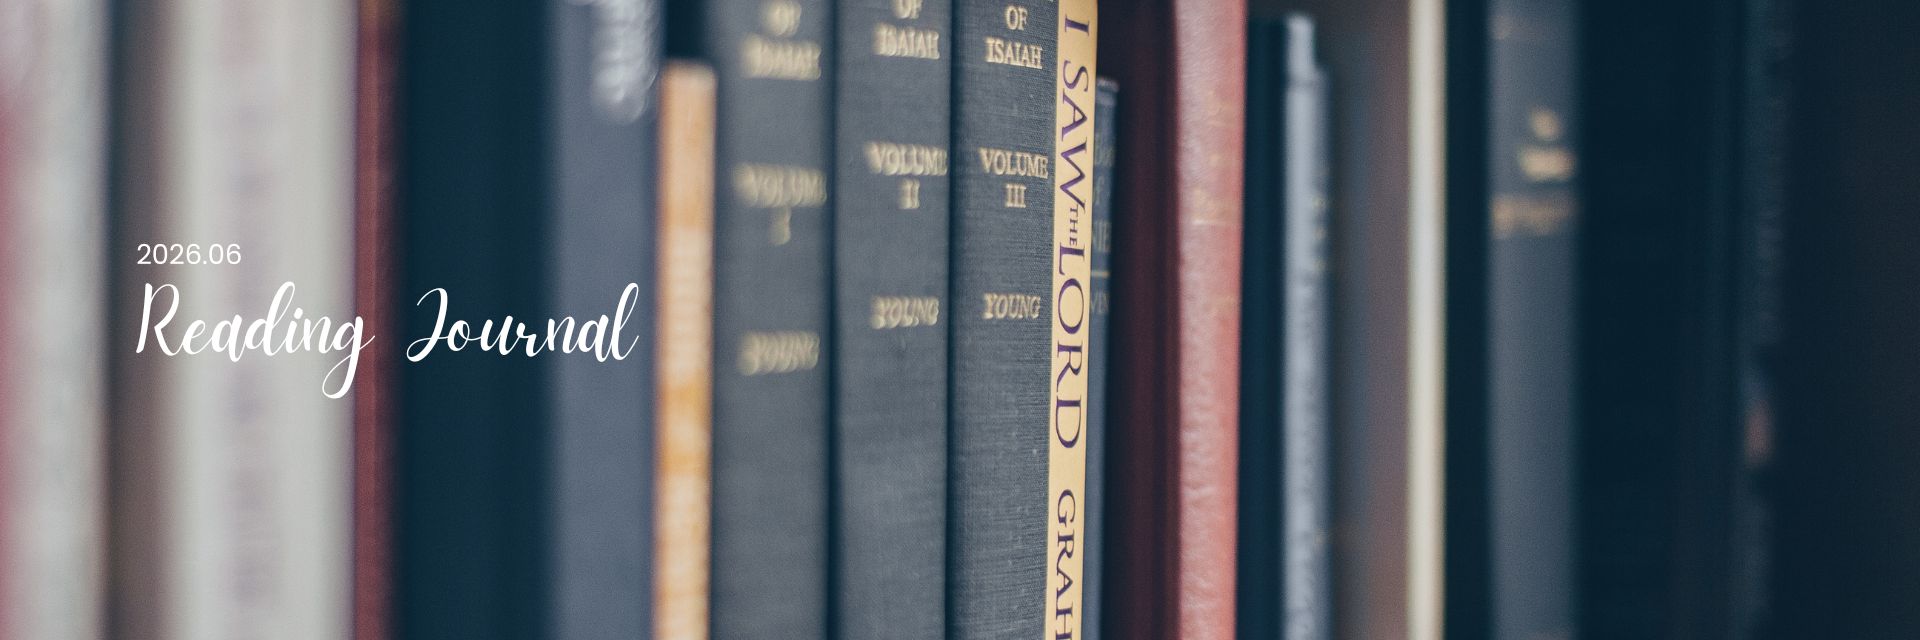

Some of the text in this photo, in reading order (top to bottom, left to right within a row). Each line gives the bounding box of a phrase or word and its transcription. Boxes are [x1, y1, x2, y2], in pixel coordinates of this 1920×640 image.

[1005, 5, 1028, 31] OF
[874, 23, 940, 60] ISAIAH
[985, 37, 1043, 69] ISAIAH
[980, 148, 1048, 179] VOLUME
[900, 178, 920, 209] II
[1005, 184, 1027, 208] III
[871, 296, 938, 328] YOUNG
[983, 294, 1040, 319] YOUNG
[1055, 14, 1090, 640] I SAW THE LORD GRAH
